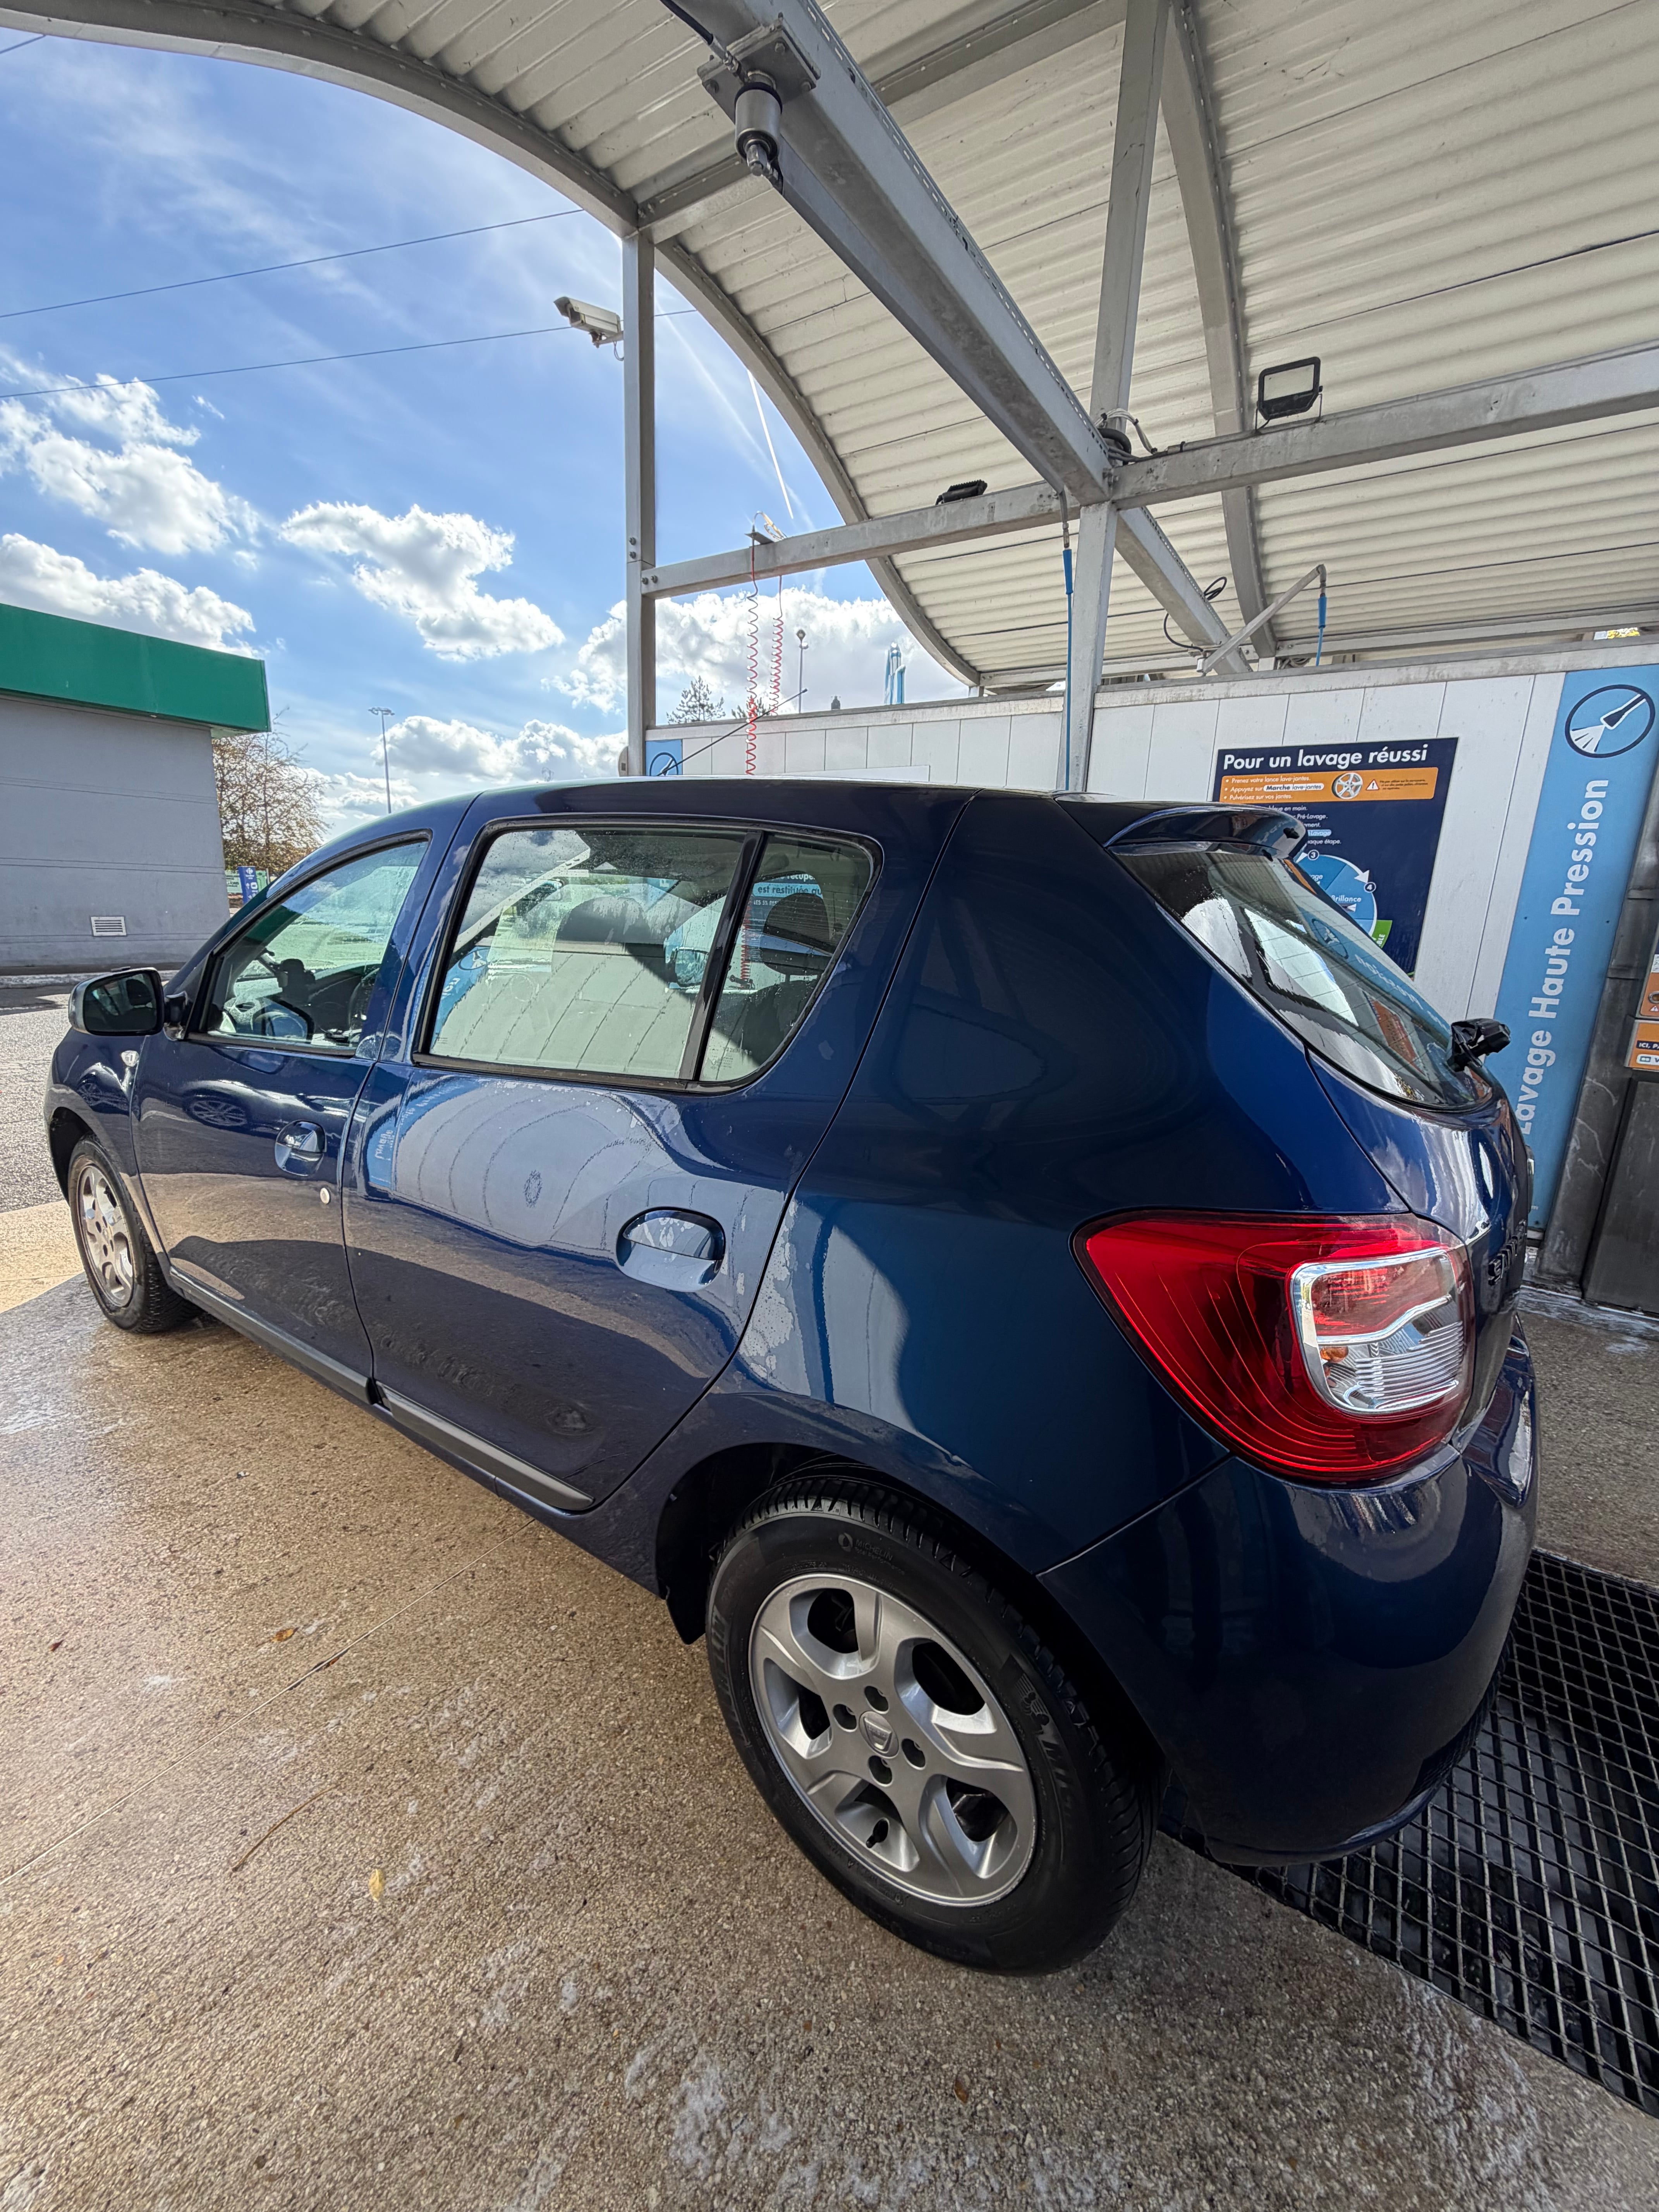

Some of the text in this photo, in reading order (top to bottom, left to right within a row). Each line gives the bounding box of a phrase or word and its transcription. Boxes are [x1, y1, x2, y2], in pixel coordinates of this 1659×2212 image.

[1223, 744, 1428, 770] Pour un lavage réussi
[1515, 779, 1609, 1135] Lavage Haute Pression
[856, 1539, 893, 1561] MICHELIN
